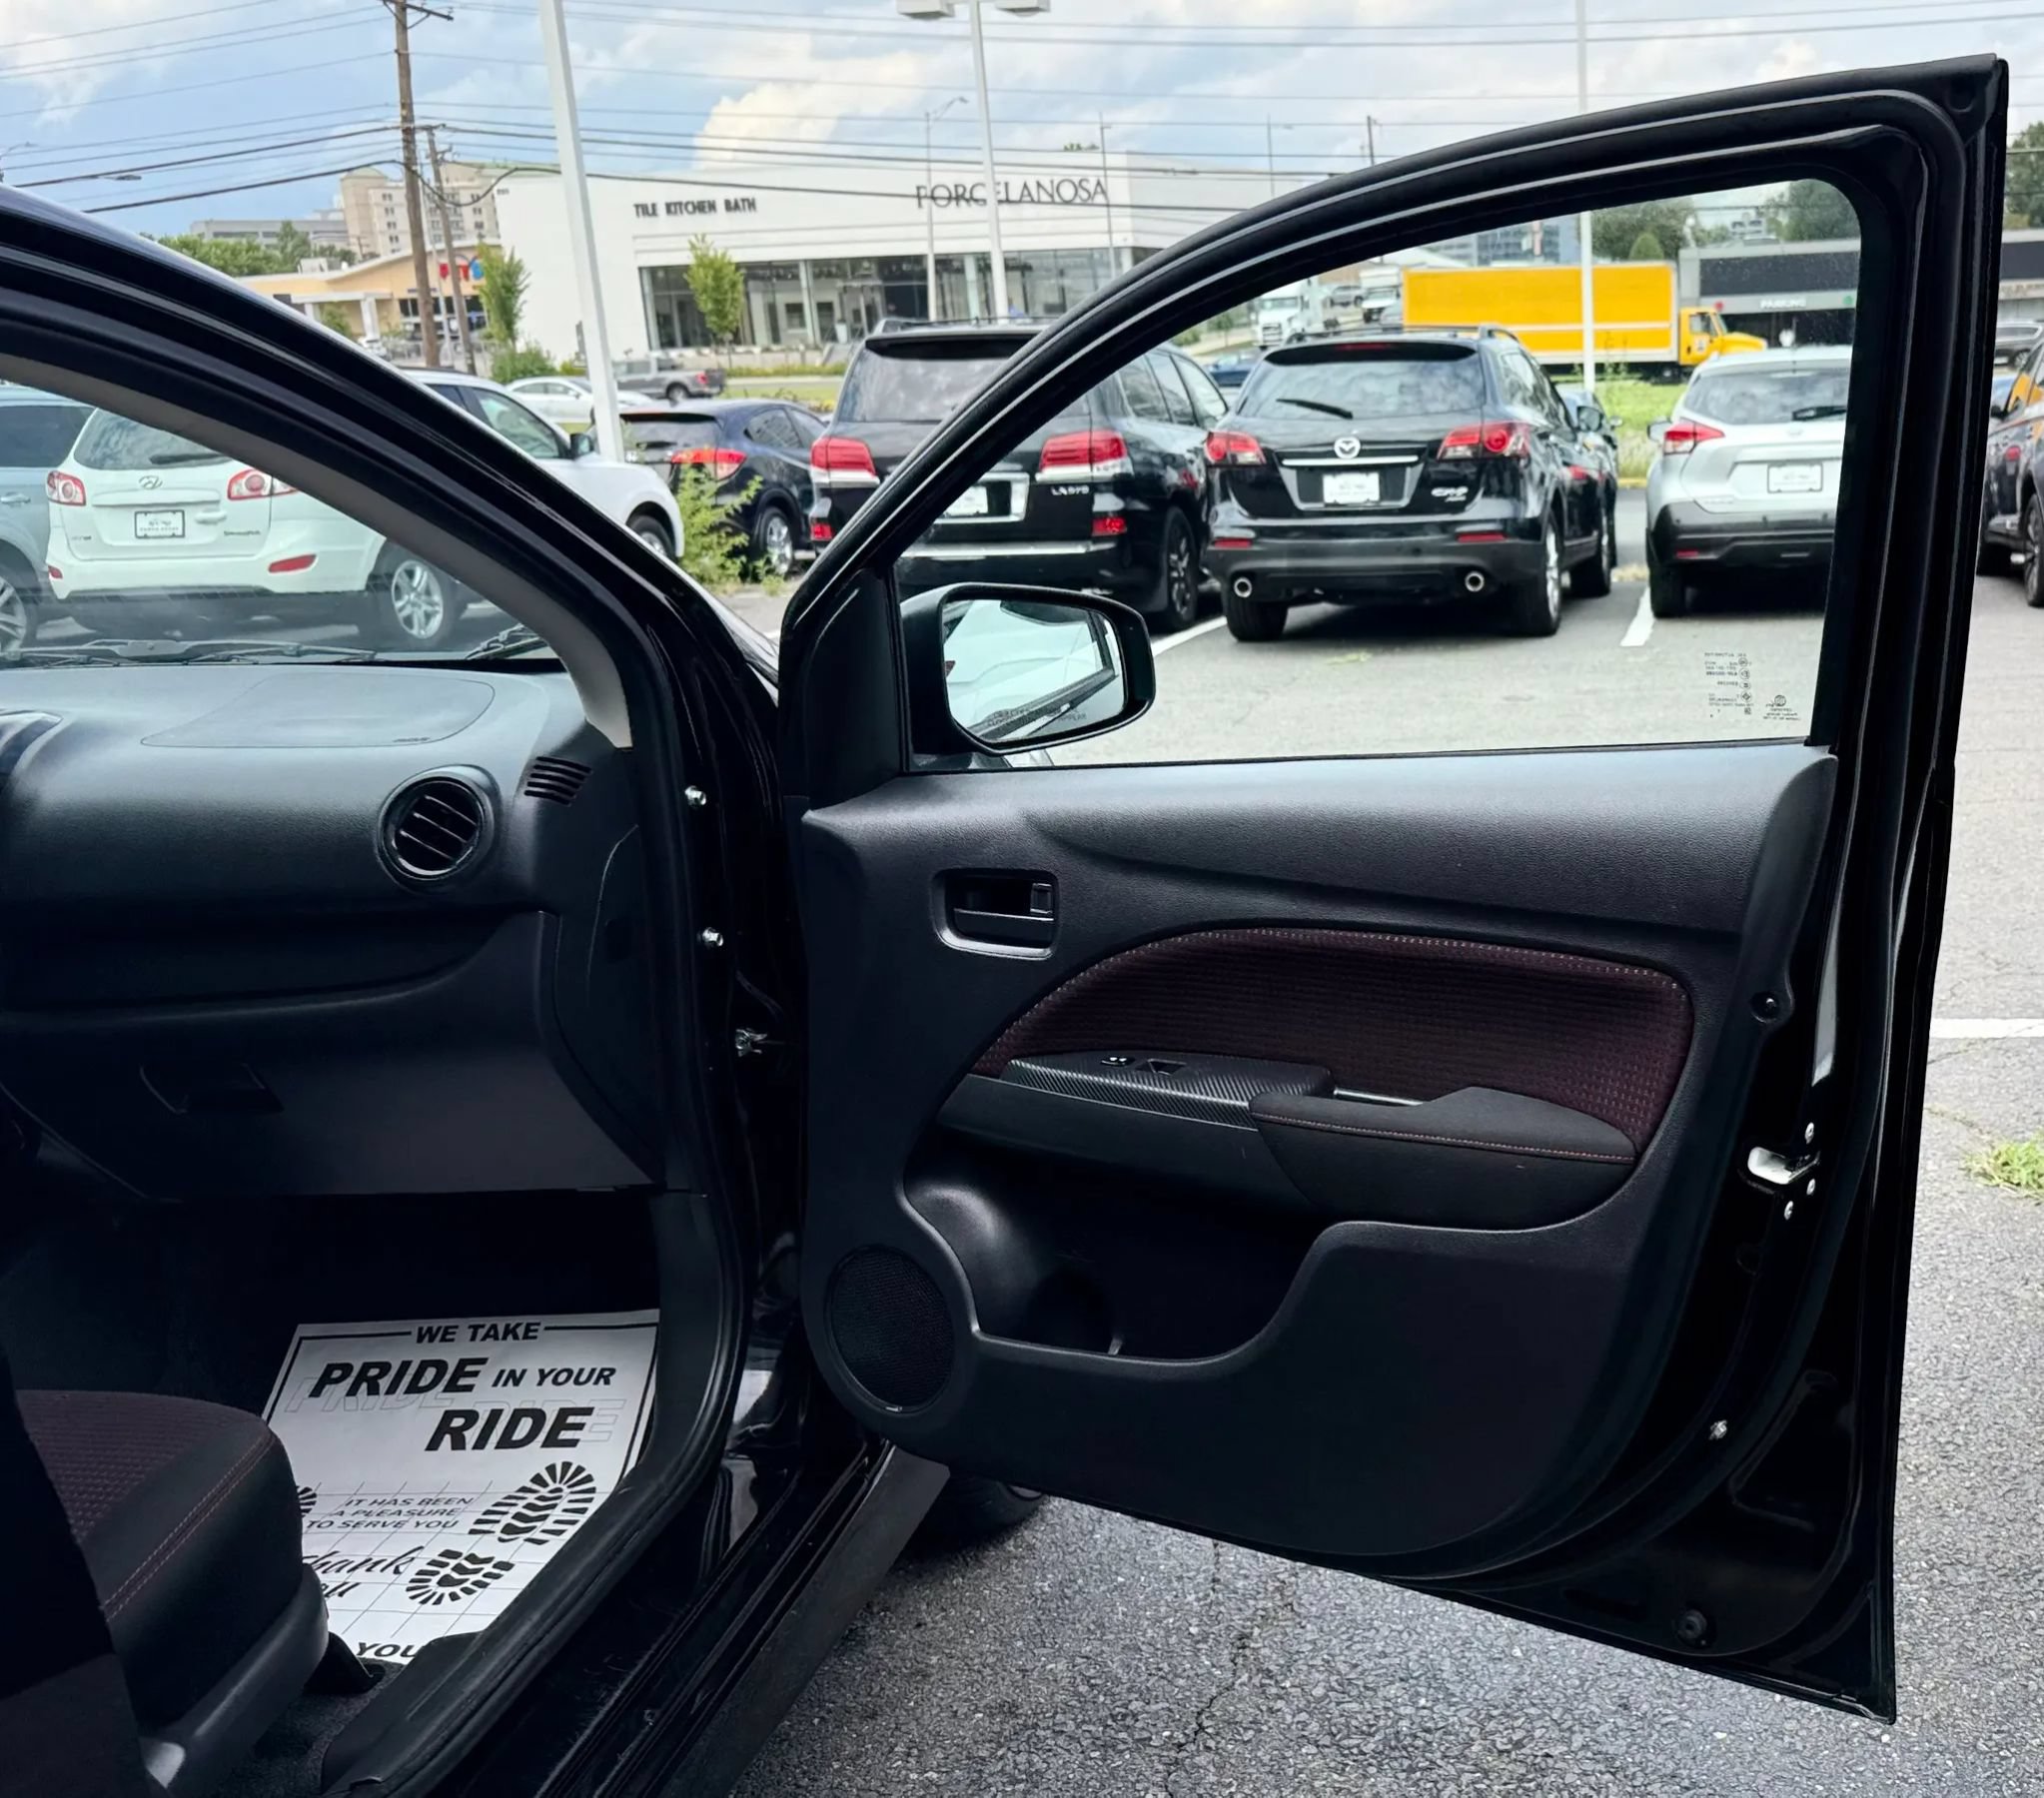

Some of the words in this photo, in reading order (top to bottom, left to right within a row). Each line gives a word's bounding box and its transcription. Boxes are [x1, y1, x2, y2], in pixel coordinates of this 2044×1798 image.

[633, 203, 657, 218] TILE
[664, 200, 716, 216] KITCHEN
[724, 198, 756, 213] BATH
[417, 1326, 459, 1344] WE
[468, 1322, 540, 1343] TAKE
[308, 1357, 489, 1398] PRIDE
[492, 1368, 526, 1387] IN
[536, 1367, 616, 1386] YOUR
[425, 1406, 594, 1451] RIDE
[352, 1508, 461, 1517] PLEASURE
